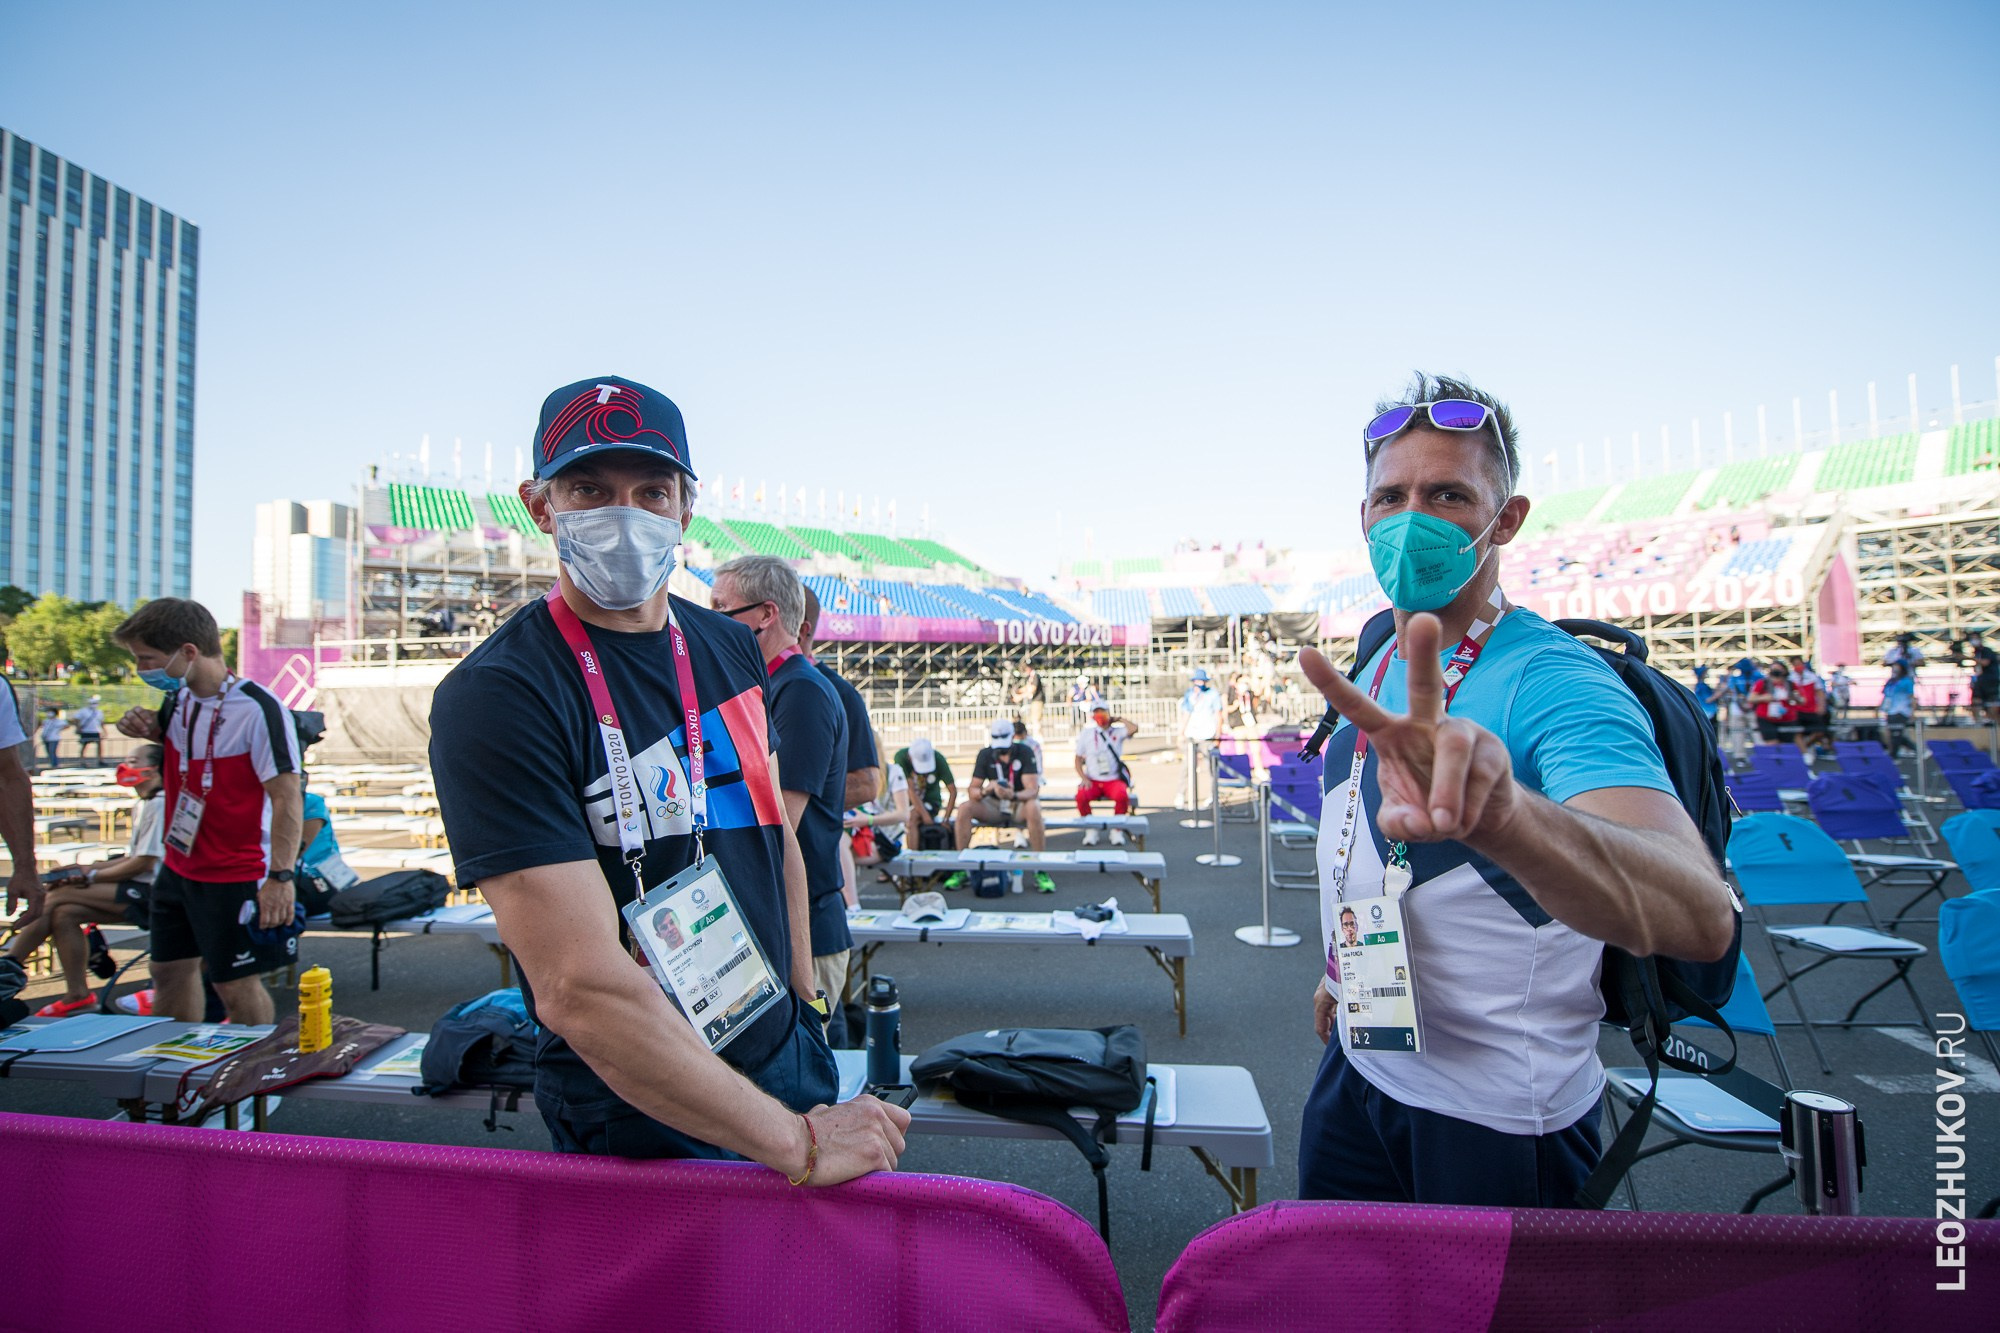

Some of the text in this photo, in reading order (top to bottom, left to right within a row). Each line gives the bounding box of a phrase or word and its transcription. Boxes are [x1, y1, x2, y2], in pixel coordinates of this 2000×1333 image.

[1542, 572, 1803, 622] TOKYO 2020
[993, 619, 1113, 647] TOKYO 2020
[687, 708, 700, 745] TOKYO
[608, 733, 633, 809] TOKYO 2020
[1351, 761, 1361, 788] 2020
[711, 983, 772, 1040] A 2 R
[1363, 1032, 1371, 1045] 2
[1405, 1032, 1414, 1046] R
